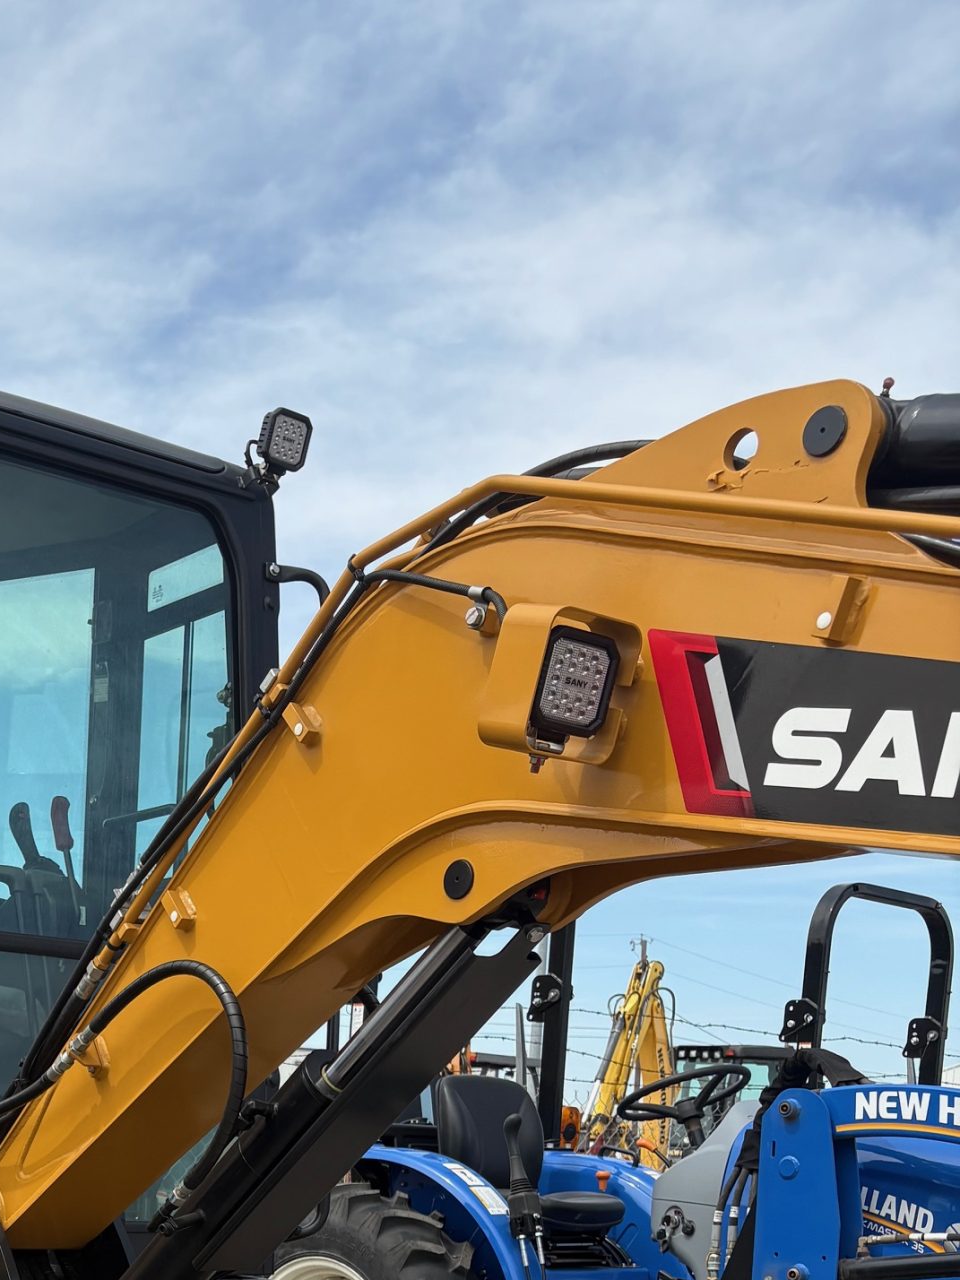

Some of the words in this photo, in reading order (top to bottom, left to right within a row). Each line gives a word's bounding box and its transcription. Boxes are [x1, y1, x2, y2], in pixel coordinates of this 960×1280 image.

[565, 677, 589, 689] SANY
[855, 1091, 931, 1121] NEW
[911, 1240, 925, 1254] 35
